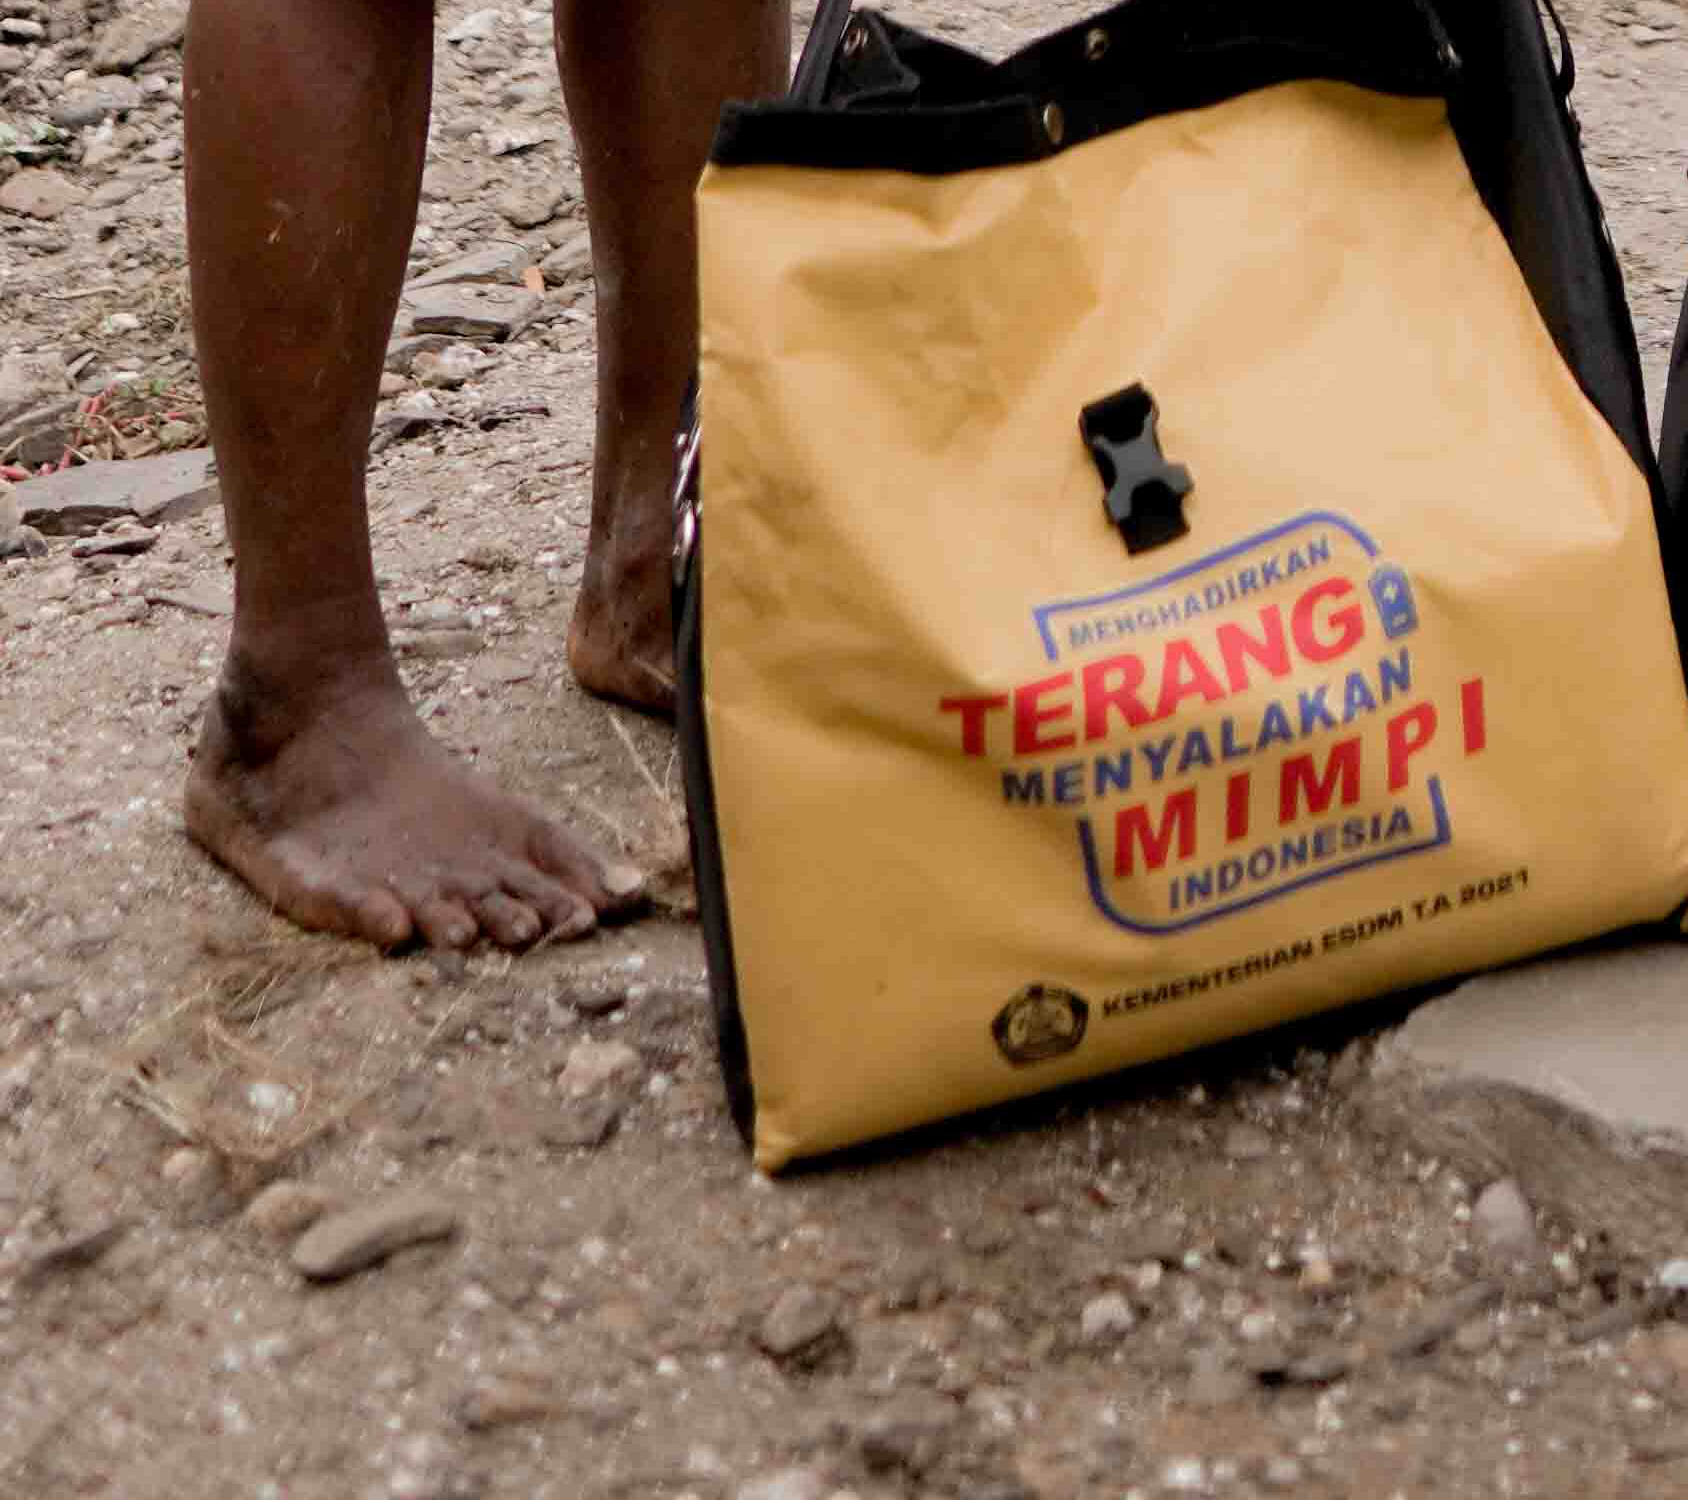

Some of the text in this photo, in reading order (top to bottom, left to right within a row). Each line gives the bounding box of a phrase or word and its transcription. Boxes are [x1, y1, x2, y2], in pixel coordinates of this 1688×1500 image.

[940, 575, 1368, 760] TERANG
[1067, 534, 1331, 647] MENGHADIRKAN
[1002, 647, 1413, 807] MENYALAKAN
[1112, 676, 1487, 878] MIMPI
[1168, 806, 1414, 913] INDONESIA
[1102, 940, 1313, 1016] KEMENTERIAN
[1320, 906, 1405, 952] ESDM
[1458, 868, 1532, 903] 2021
